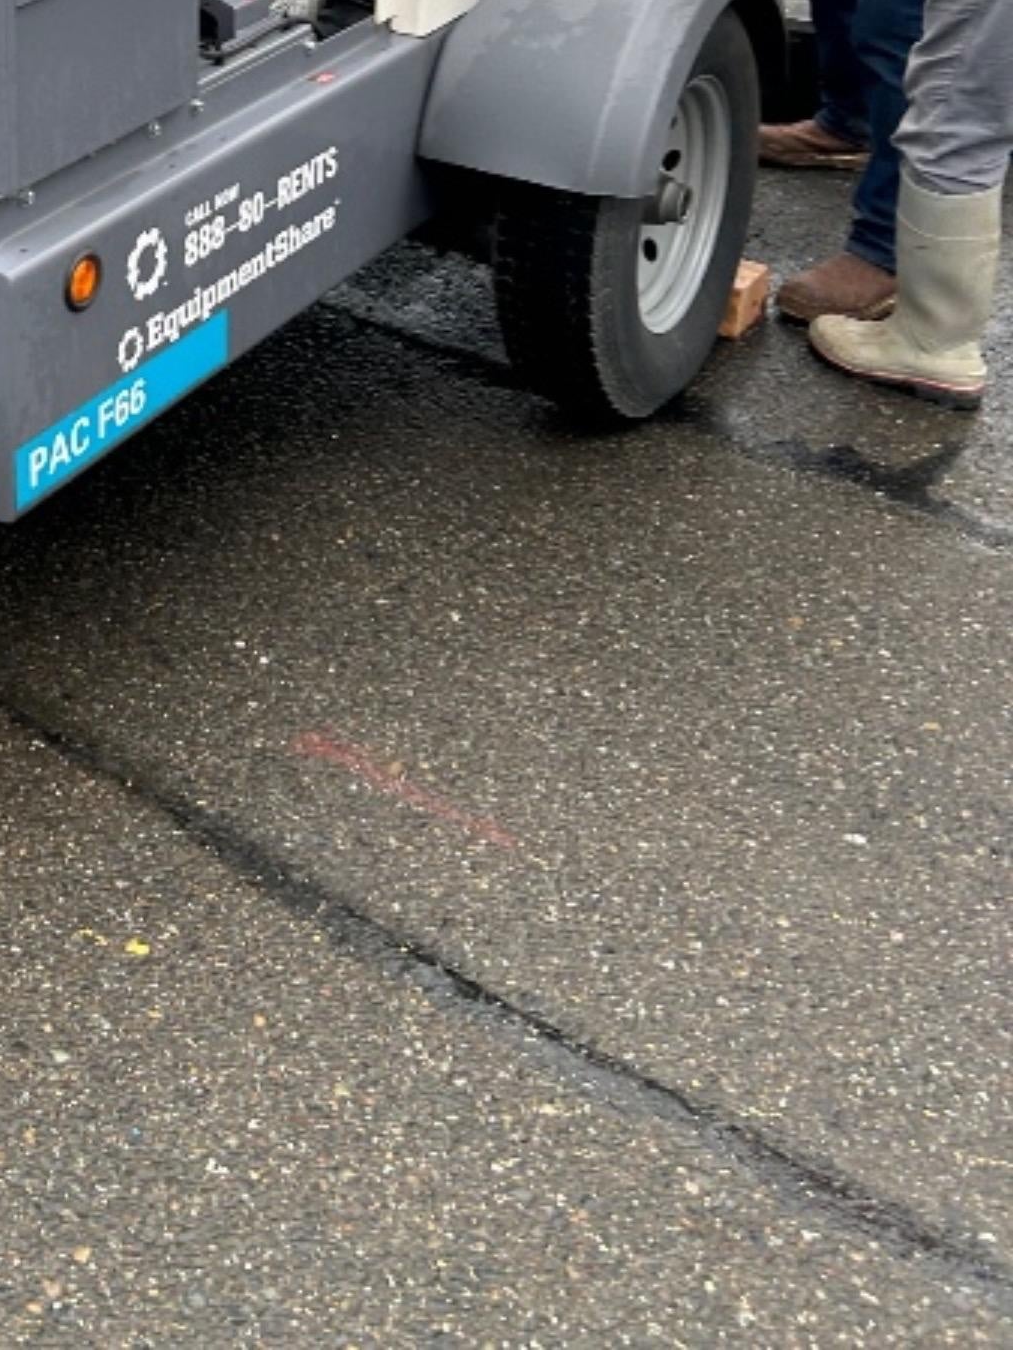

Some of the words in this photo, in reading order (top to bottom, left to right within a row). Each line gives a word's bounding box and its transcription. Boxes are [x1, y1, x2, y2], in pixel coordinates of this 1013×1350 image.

[146, 205, 336, 351] EquipmentShare
[28, 415, 91, 488] PAC
[97, 378, 147, 440] F66
